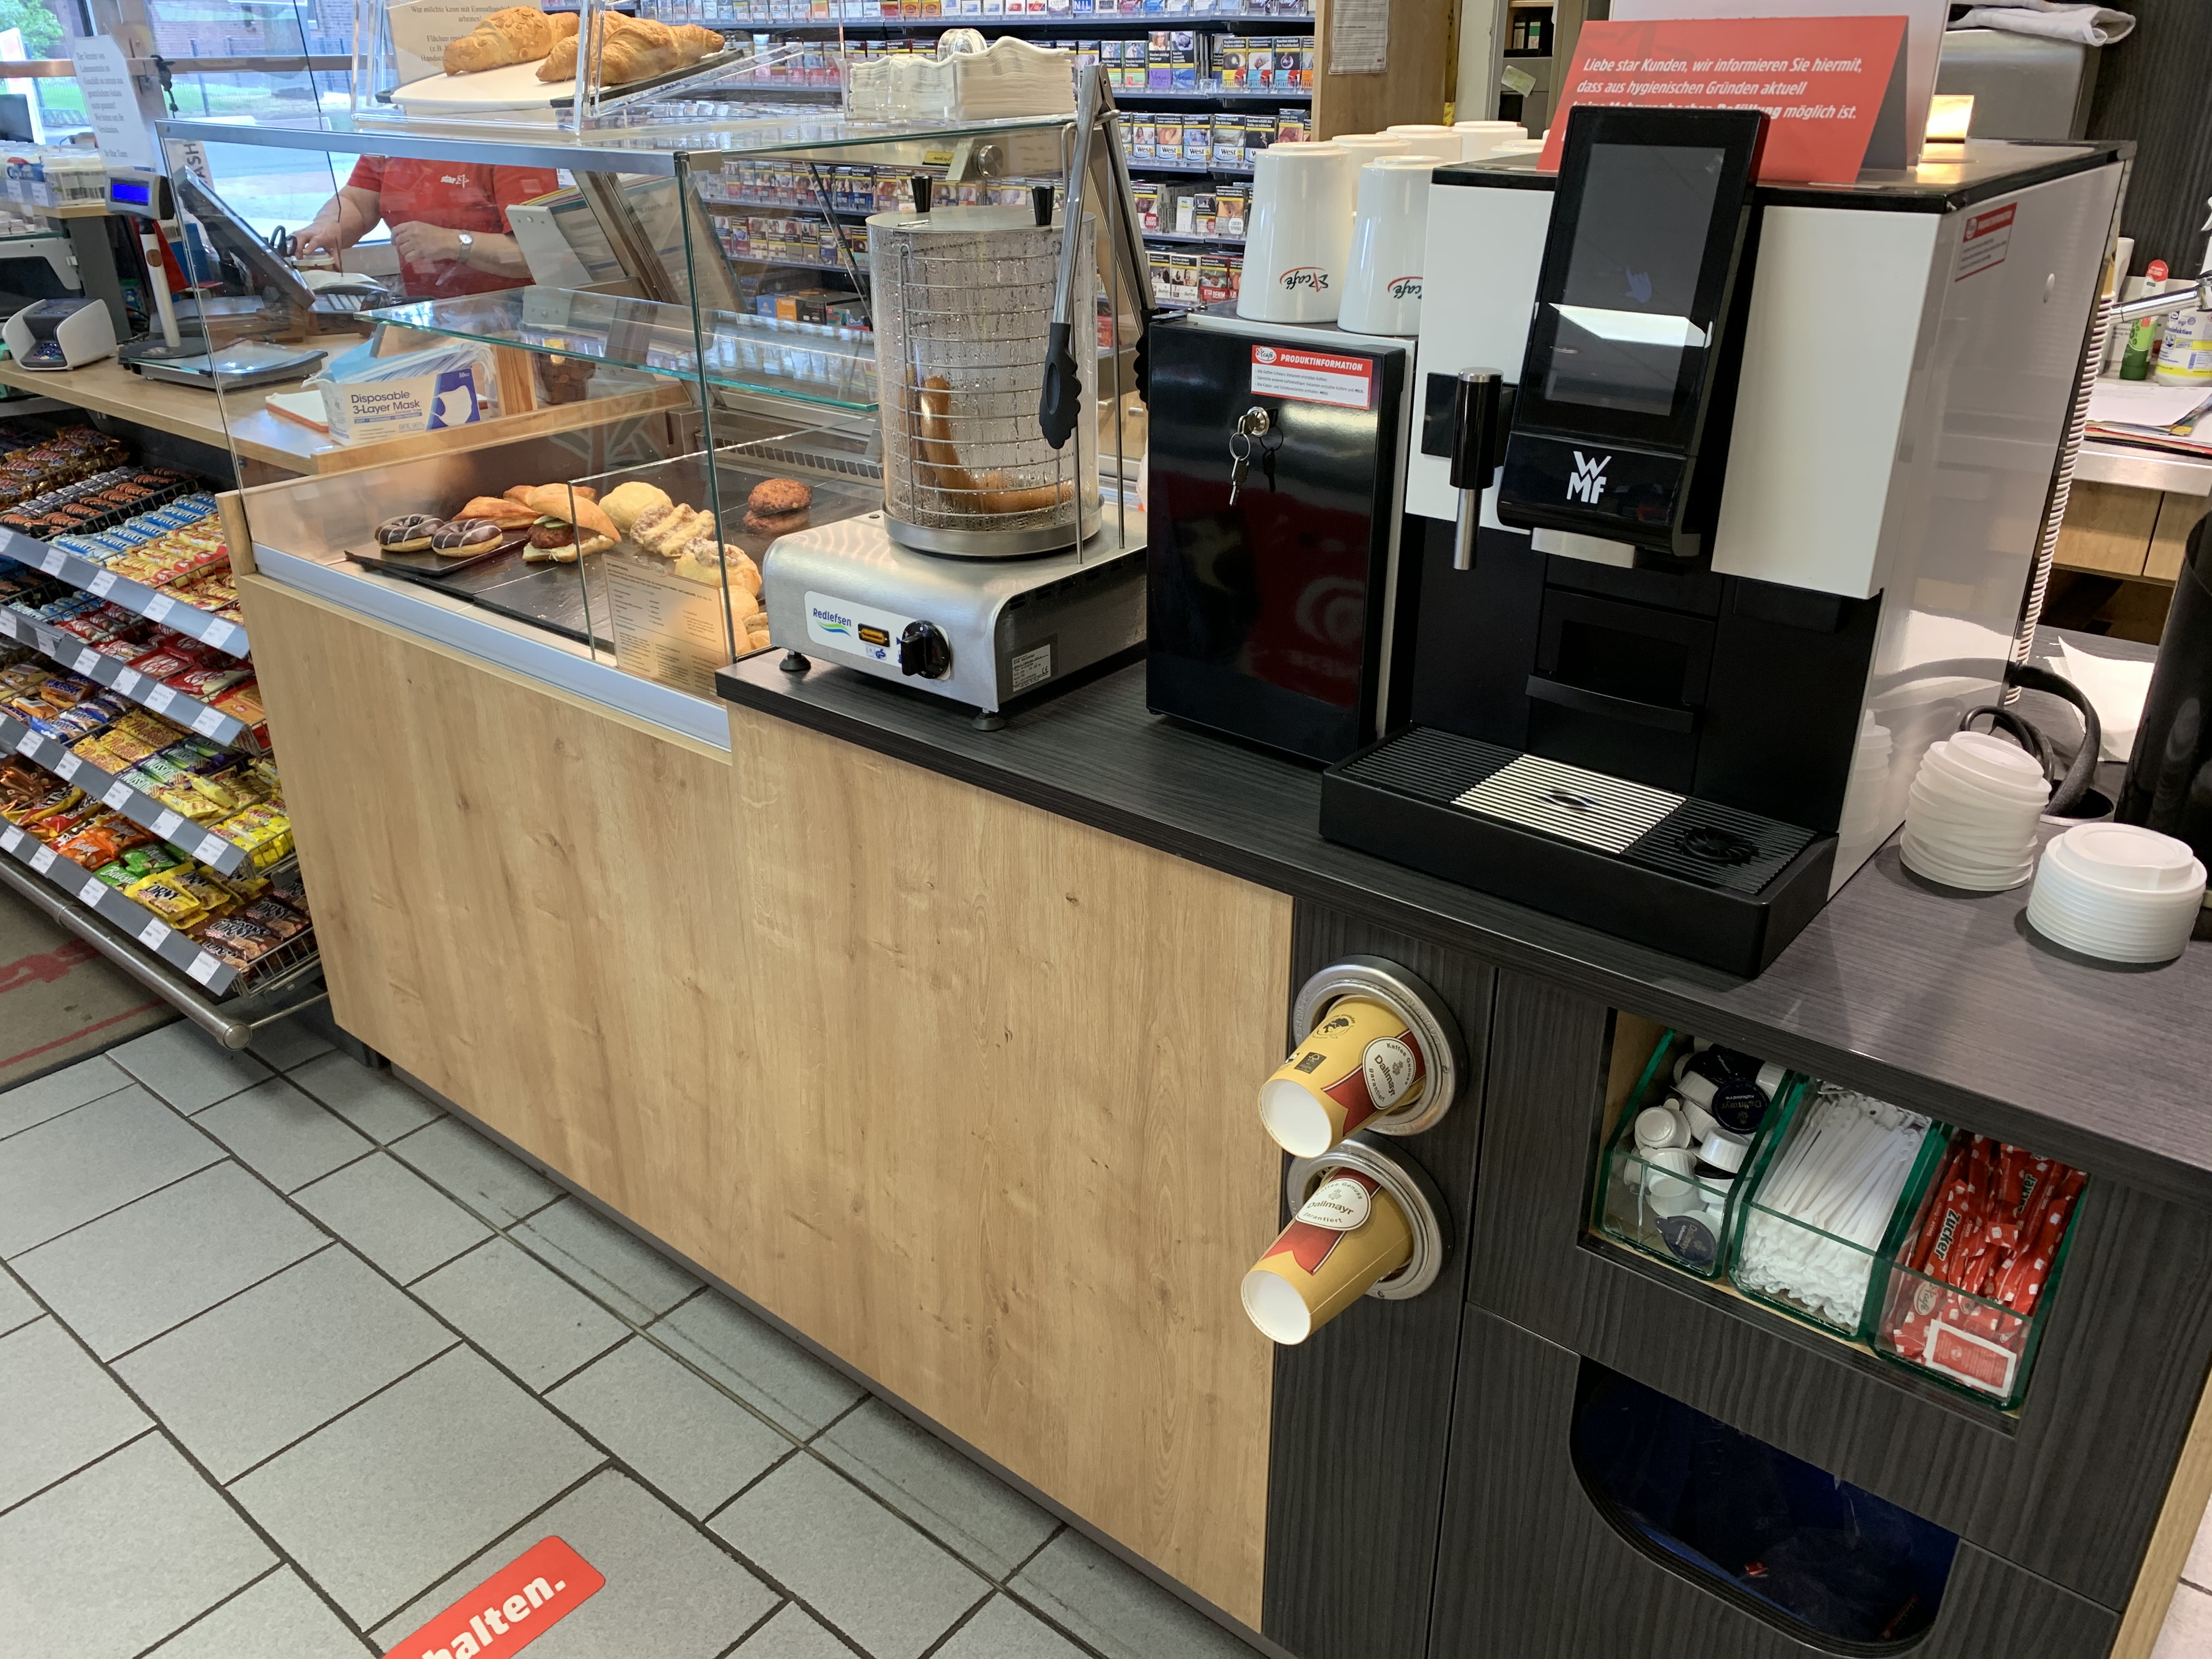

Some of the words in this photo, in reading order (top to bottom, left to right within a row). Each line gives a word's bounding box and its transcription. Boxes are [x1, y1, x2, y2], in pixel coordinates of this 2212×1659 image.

[1073, 0, 1091, 10] NIL
[1583, 58, 1615, 72] Liebe
[1617, 60, 1640, 71] star
[1640, 58, 1688, 73] Kunden,
[1692, 59, 1712, 71] wir
[1714, 58, 1788, 72] informieren
[1790, 58, 1810, 72] Sie
[1812, 58, 1863, 74] hiermit,
[1151, 71, 1168, 83] Vogue
[1173, 71, 1190, 83] Vogue
[1577, 80, 1602, 93] dass
[1604, 82, 1625, 93] aus
[1627, 81, 1703, 95] hygienischen
[1706, 81, 1758, 95] Gründen
[1760, 81, 1807, 95] aktuell
[1782, 105, 1835, 120] möglich
[1837, 105, 1856, 119] ist.
[1212, 290, 1226, 298] DENIM
[1280, 354, 1363, 371] PRODUKTINFORMATION
[351, 391, 410, 404] Disposable
[353, 404, 391, 414] 3-Layer
[393, 400, 420, 410] Mask
[813, 608, 851, 627] Redlefsen
[100, 867, 139, 884] Balisto
[206, 929, 224, 939] BIG
[1386, 1043, 1407, 1057] Kaffee
[1374, 1054, 1396, 1096] Dallmayr
[1369, 1068, 1385, 1102] garantiert
[1721, 1101, 1762, 1109] Dallmayr
[1342, 1182, 1363, 1199] Genuss
[1307, 1200, 1354, 1215] Dallmayr
[1304, 1212, 1342, 1222] garantiert
[1934, 1207, 1962, 1261] Zucker
